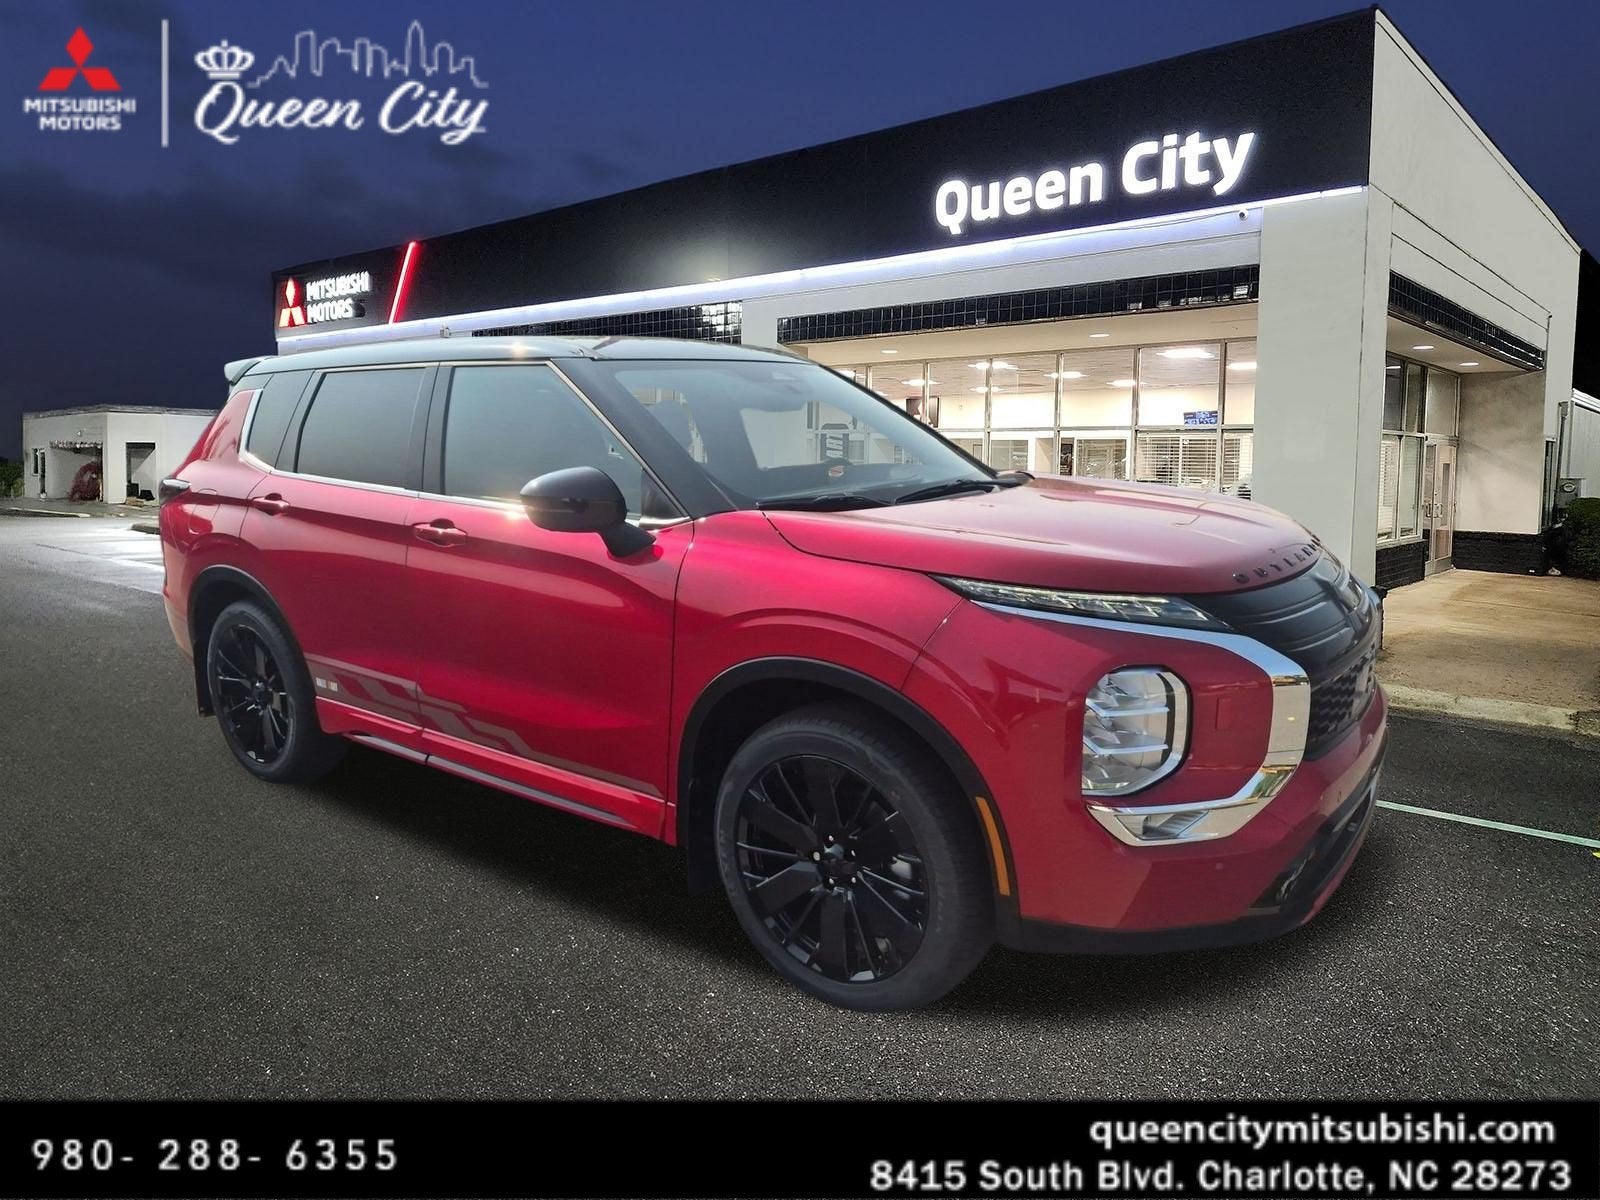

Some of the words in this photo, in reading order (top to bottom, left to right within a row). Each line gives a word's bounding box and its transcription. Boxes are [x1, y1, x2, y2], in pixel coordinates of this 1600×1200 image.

[935, 161, 1104, 235] Queen
[1121, 131, 1255, 196] City
[306, 271, 370, 301] MITSUBISHI
[306, 298, 354, 323] MOTORS
